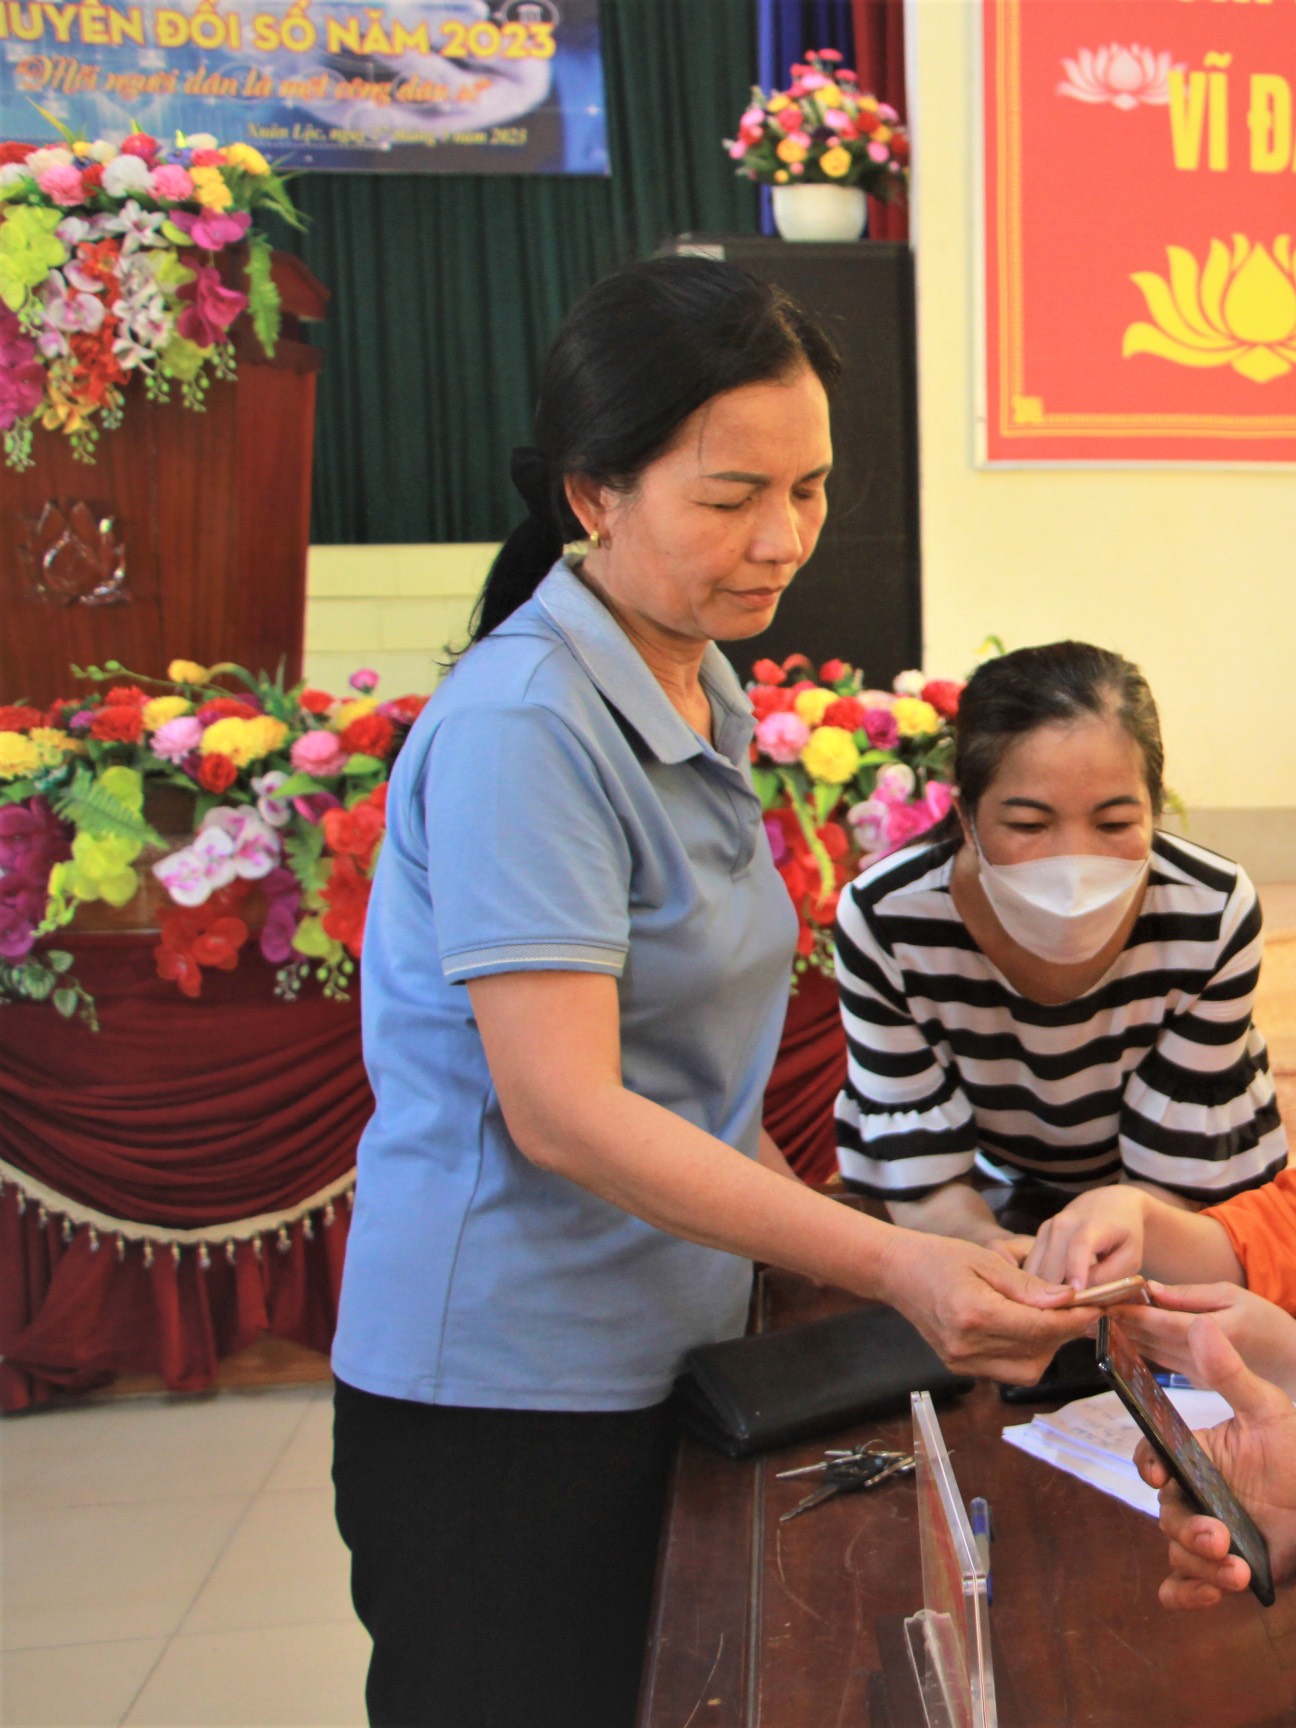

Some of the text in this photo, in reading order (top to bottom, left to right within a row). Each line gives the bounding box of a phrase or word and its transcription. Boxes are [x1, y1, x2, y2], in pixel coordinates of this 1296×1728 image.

[253, 0, 318, 53] SỐ
[326, 9, 431, 55] NĂM
[439, 21, 557, 59] 2023
[1168, 51, 1232, 172] VĨ
